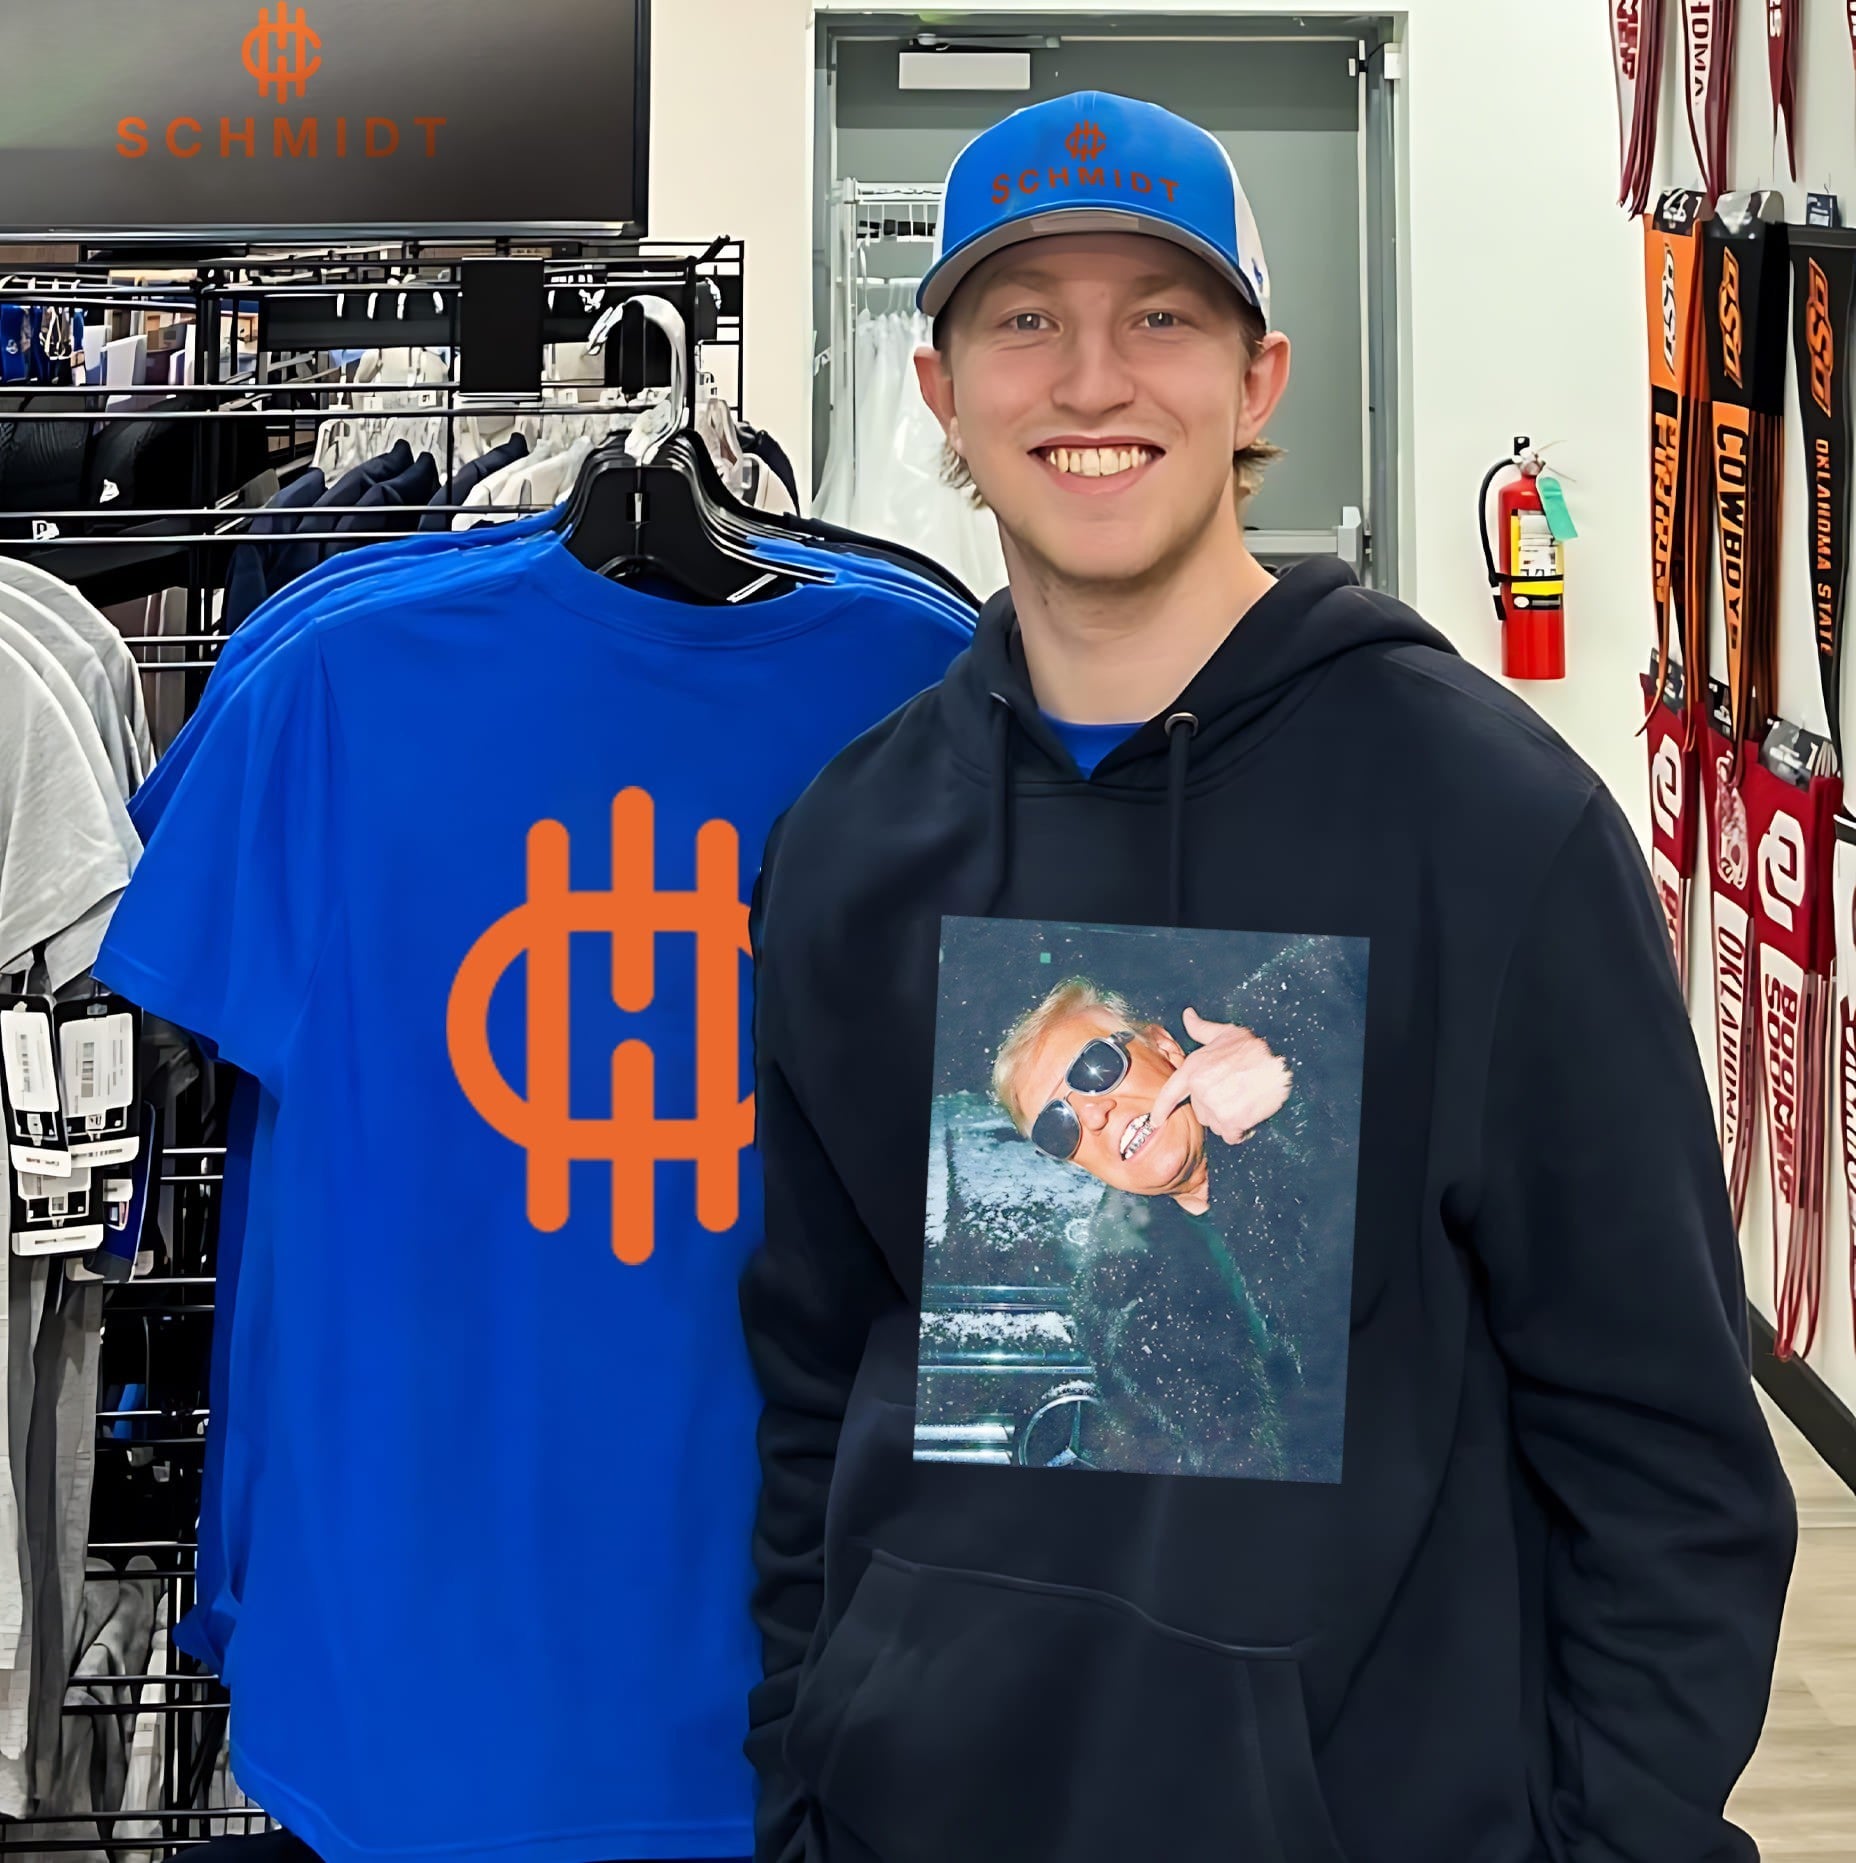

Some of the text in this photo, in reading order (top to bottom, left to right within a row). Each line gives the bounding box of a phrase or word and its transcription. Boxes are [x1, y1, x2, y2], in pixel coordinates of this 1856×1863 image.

[115, 116, 448, 159] SCHMIDT
[991, 167, 1179, 205] SCHMIDT
[1815, 438, 1832, 570] OKLAHOMA
[1717, 925, 1745, 1144] OKLAHOMA
